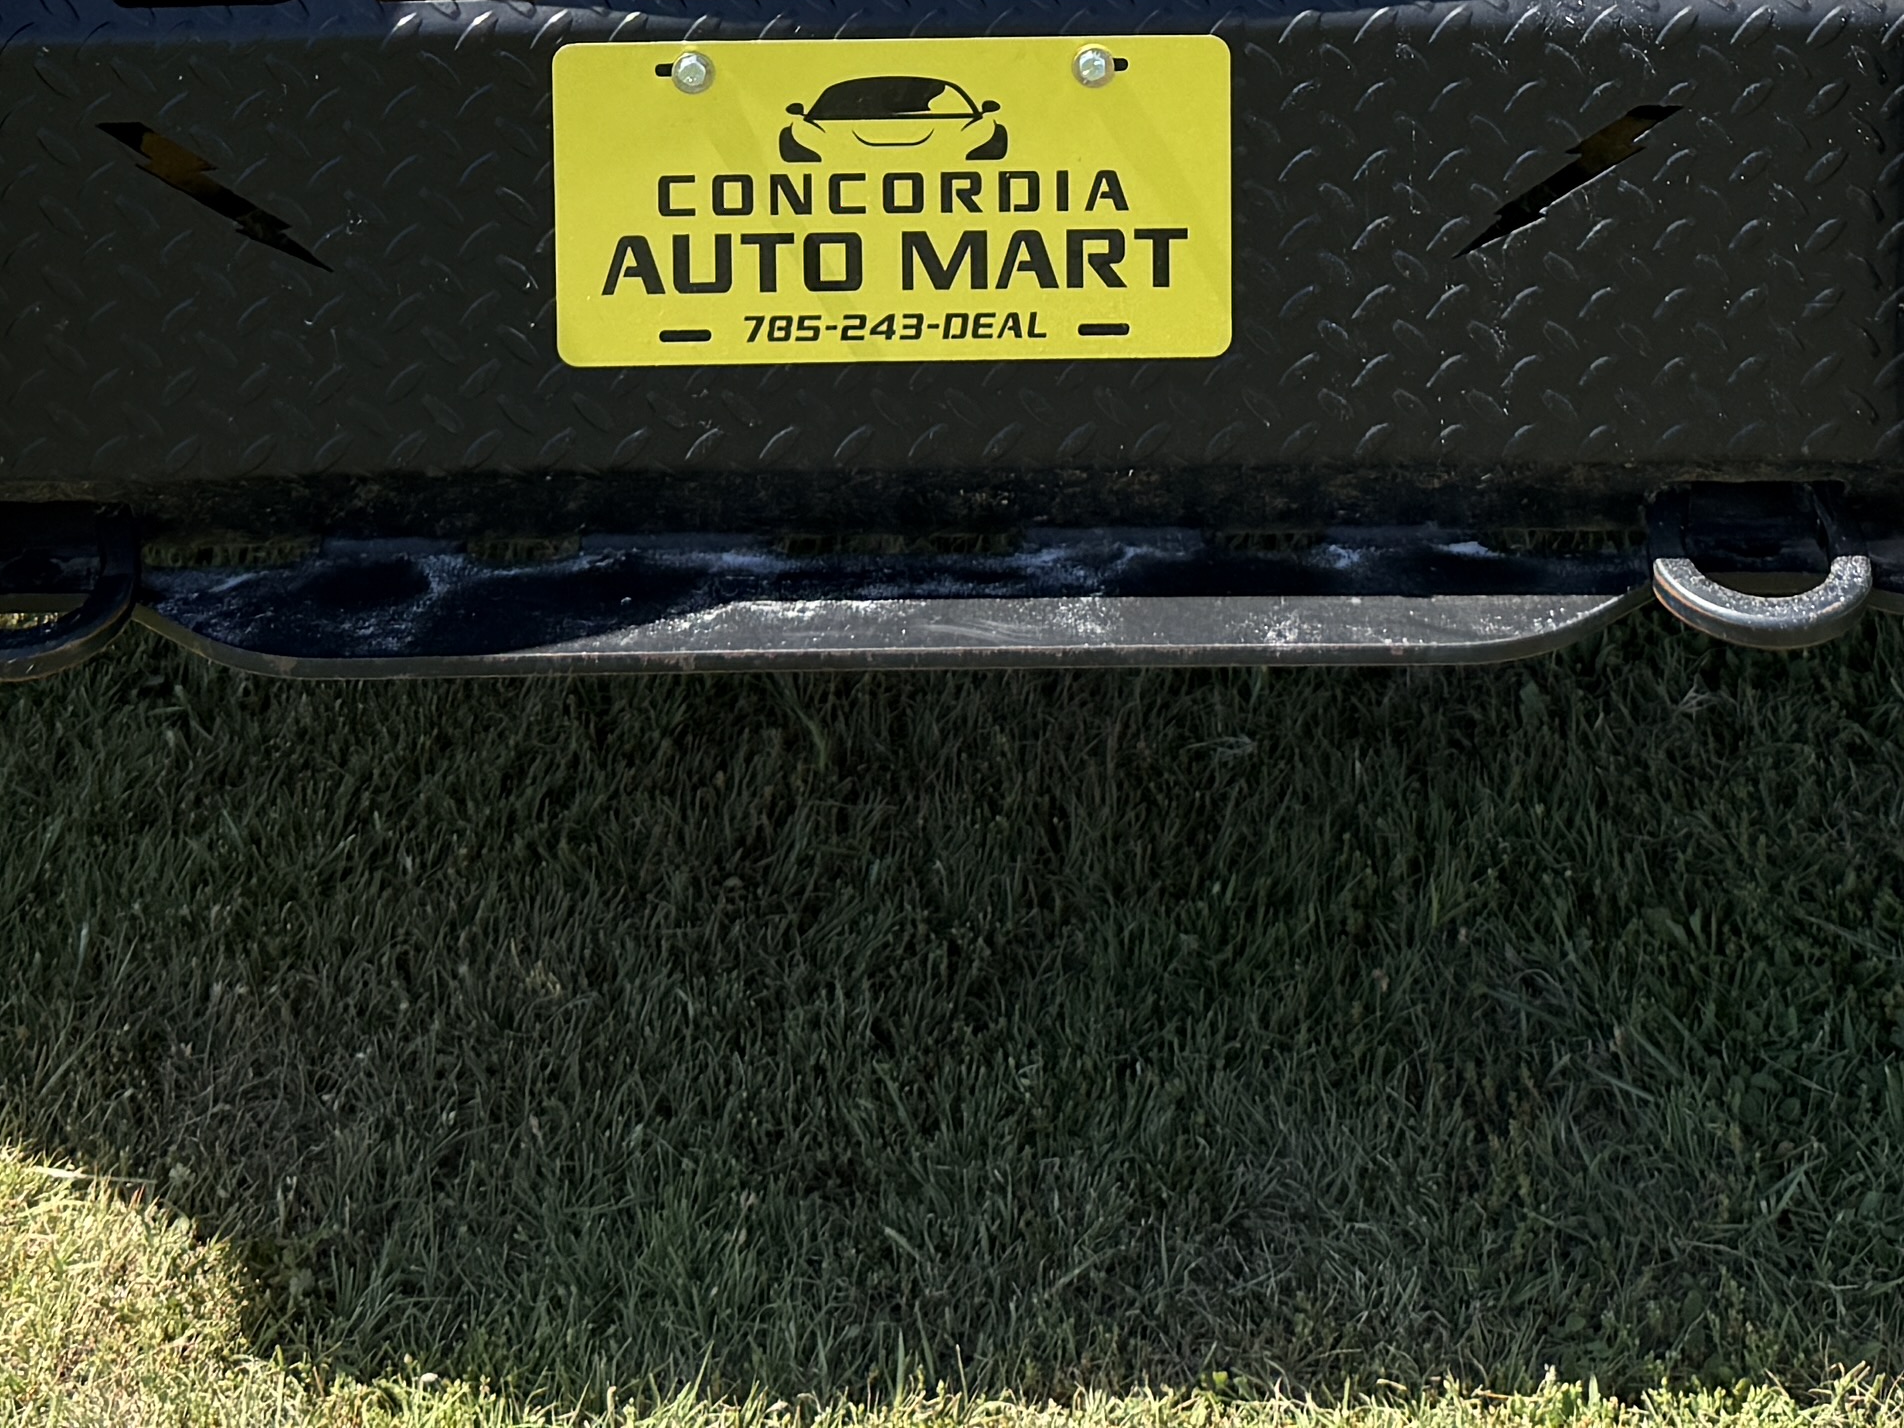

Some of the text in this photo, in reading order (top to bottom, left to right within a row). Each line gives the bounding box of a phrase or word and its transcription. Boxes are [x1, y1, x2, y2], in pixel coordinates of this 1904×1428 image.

[657, 169, 1130, 217] CONCORDIA
[601, 227, 1189, 296] AUTO MART
[743, 311, 1047, 343] 785-243-DEAL
